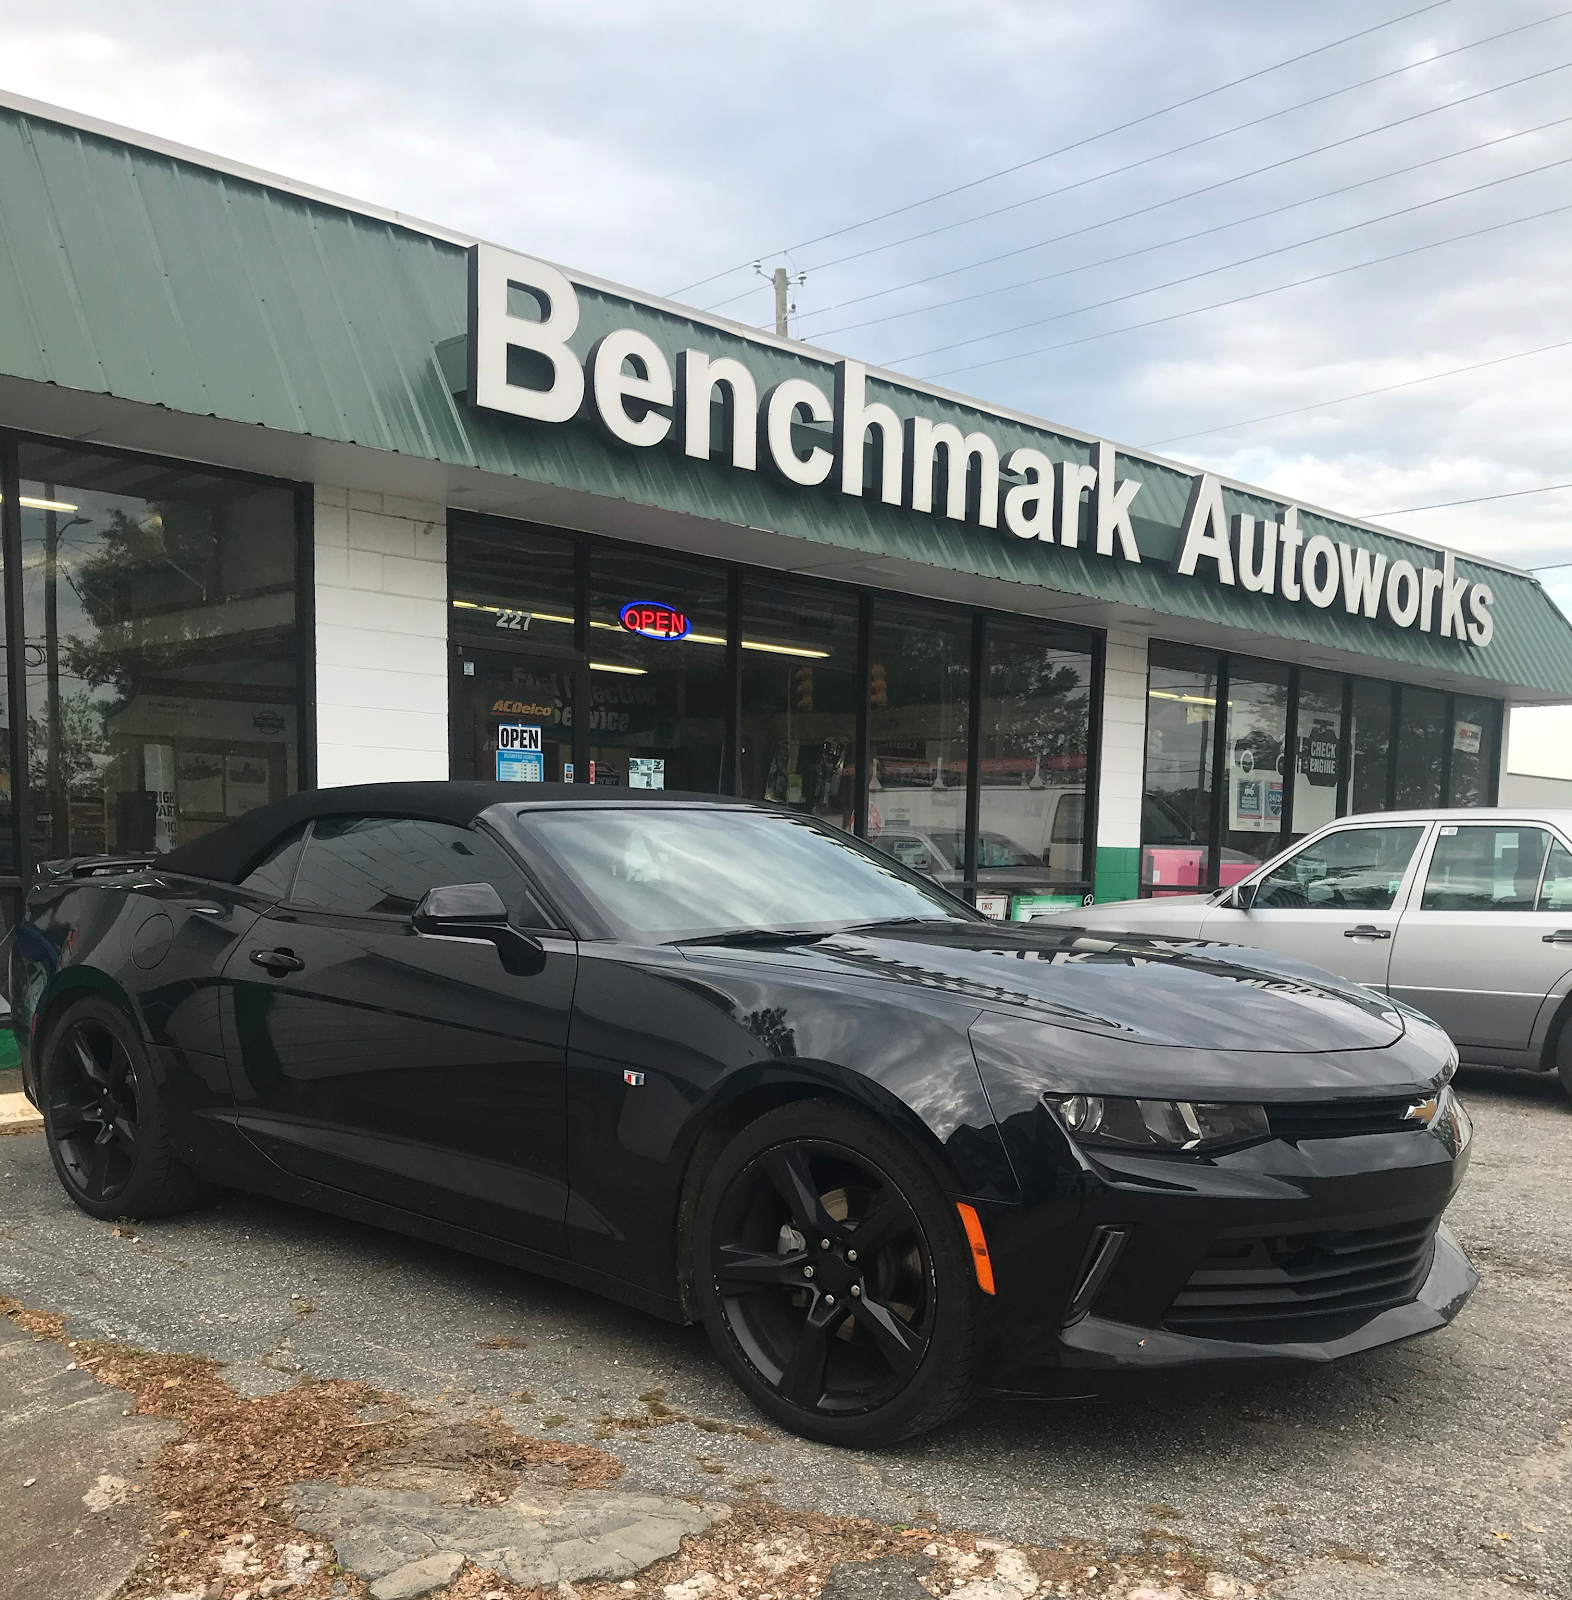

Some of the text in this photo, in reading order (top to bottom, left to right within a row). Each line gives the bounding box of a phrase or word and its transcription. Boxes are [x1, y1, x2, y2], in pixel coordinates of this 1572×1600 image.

[469, 241, 1495, 648] Benchmark Autoworks
[496, 608, 532, 631] 227
[624, 609, 685, 634] OPEN
[492, 699, 552, 716] ACDelco
[500, 727, 540, 749] OPEN
[1311, 741, 1337, 759] CHECK
[1309, 758, 1336, 774] ENGINE
